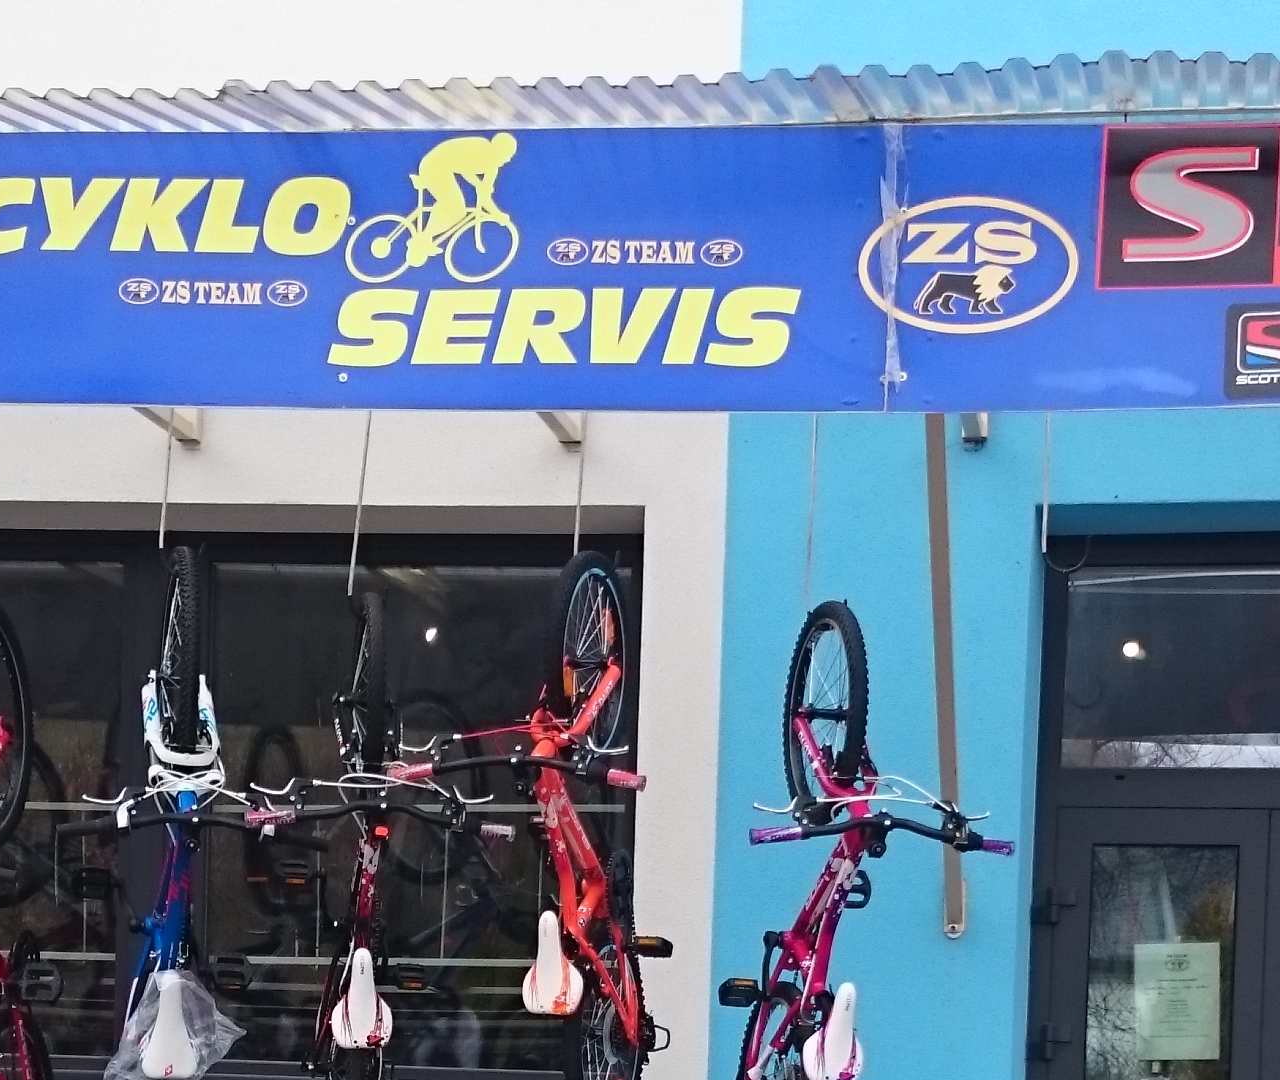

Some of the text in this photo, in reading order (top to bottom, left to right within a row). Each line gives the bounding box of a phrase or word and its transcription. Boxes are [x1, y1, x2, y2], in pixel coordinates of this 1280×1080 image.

[591, 240, 621, 265] ZS
[624, 241, 695, 264] TEAM
[906, 221, 1038, 265] ZS
[162, 280, 190, 304] ZS
[194, 282, 263, 305] TEAM
[327, 287, 802, 367] SERVIS
